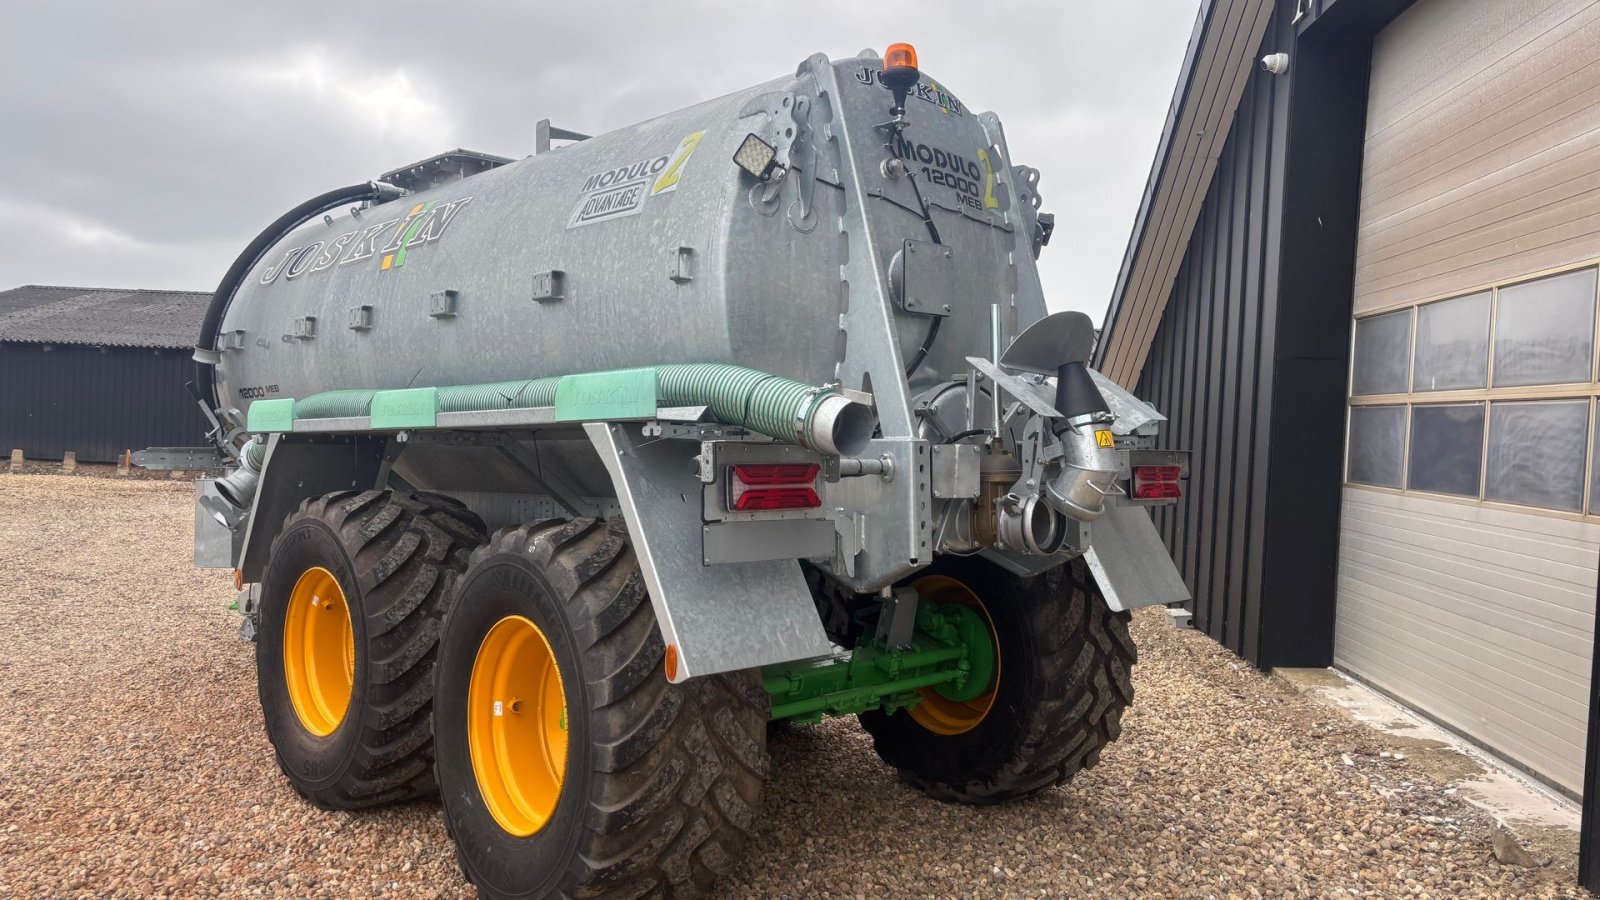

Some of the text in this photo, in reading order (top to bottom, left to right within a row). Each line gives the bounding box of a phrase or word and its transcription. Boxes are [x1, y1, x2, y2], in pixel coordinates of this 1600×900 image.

[855, 66, 962, 117] JKIN
[581, 155, 669, 192] MODULO
[896, 138, 981, 182] MODULO
[922, 167, 979, 198] 12000
[575, 187, 640, 223] ADVANTAGE
[956, 192, 983, 211] MEB
[260, 196, 474, 285] JOSKIN
[239, 384, 279, 399] 12000 MEB
